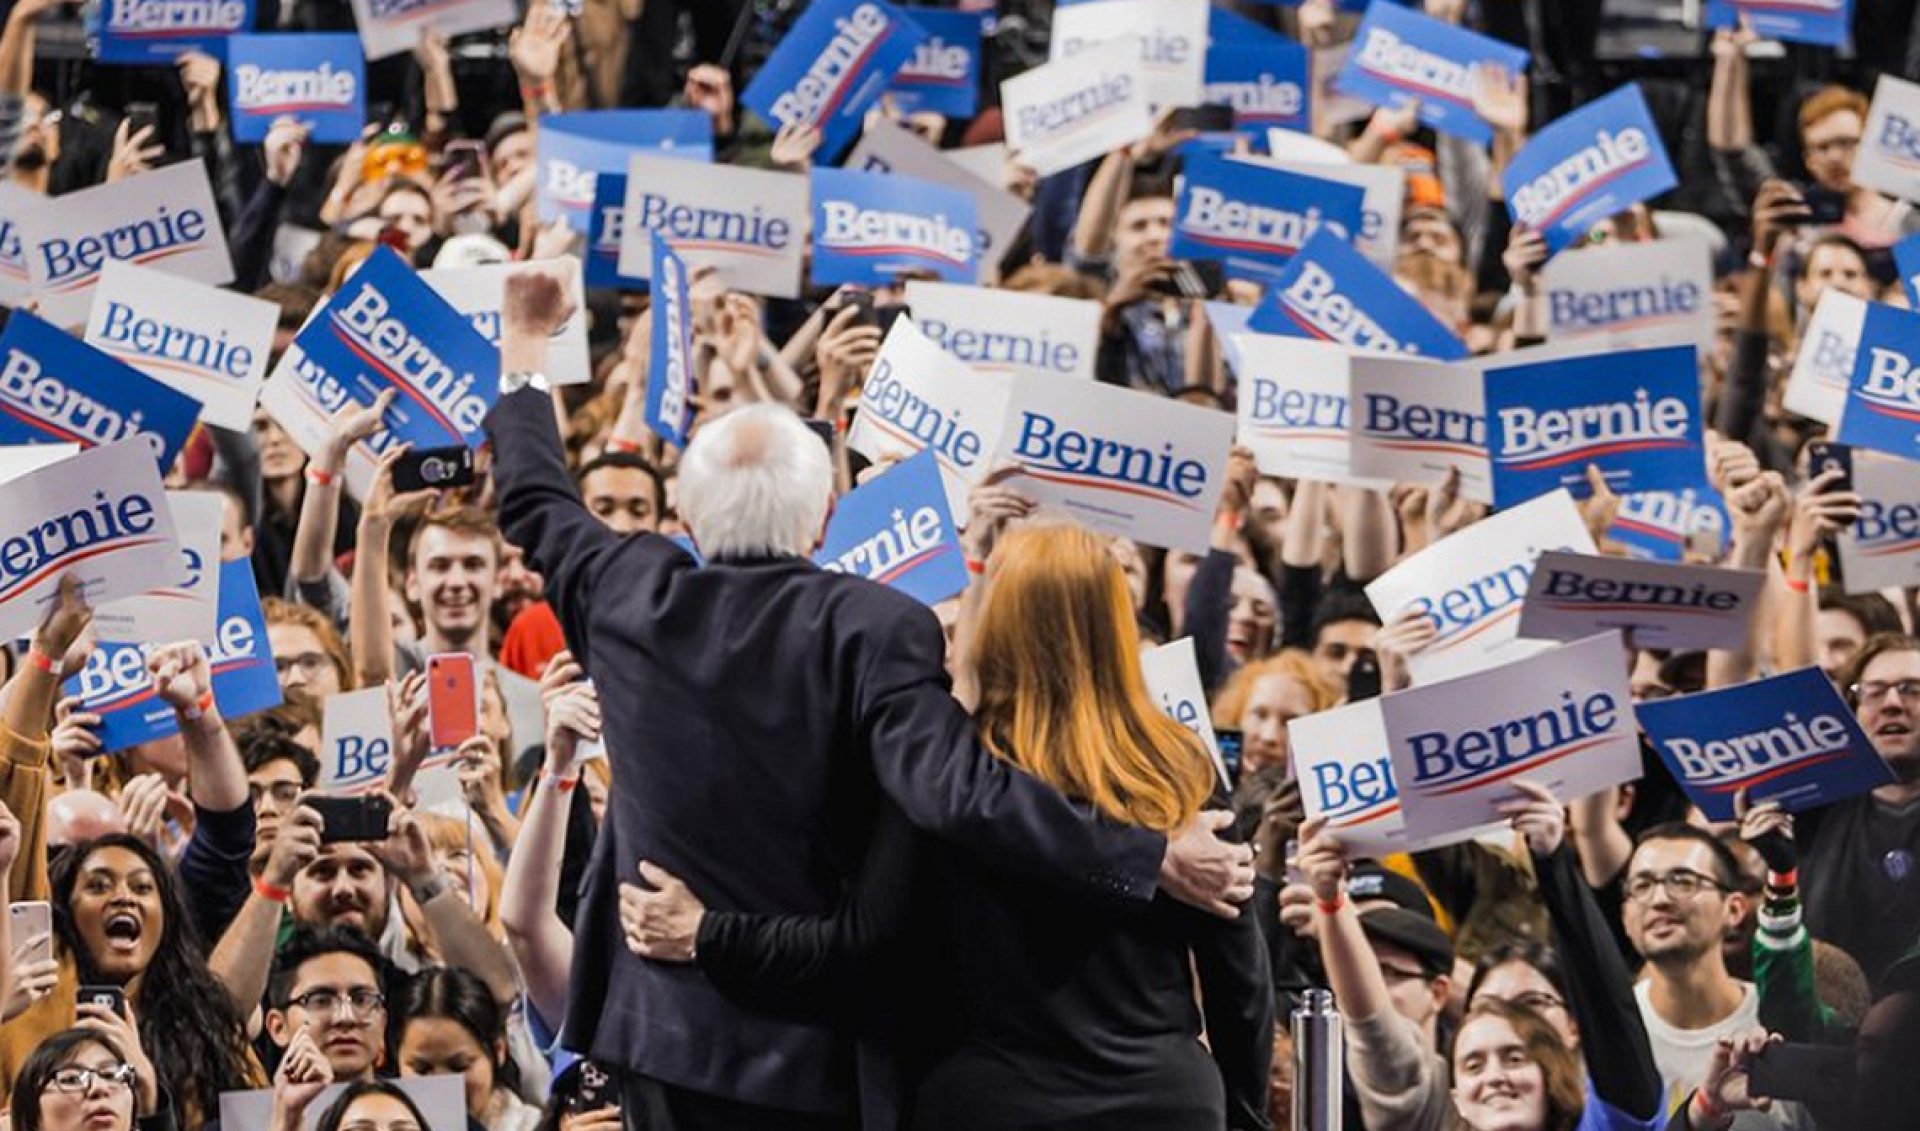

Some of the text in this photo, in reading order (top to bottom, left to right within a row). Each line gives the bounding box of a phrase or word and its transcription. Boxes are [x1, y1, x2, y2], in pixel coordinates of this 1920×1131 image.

[235, 61, 356, 105] Bernie
[39, 205, 207, 281] Bernie
[639, 193, 790, 250] Bernie
[820, 200, 972, 262] Bernie
[1549, 274, 1699, 328] Bernie
[100, 301, 253, 378] Bernie
[339, 282, 489, 434] Bernie
[863, 359, 982, 468] Bernie
[1364, 393, 1486, 447] Bern
[1498, 387, 1689, 456] Bernie
[1013, 411, 1207, 497] Bernie
[0, 489, 154, 577] ernie
[1539, 568, 1744, 612] Bernie
[1406, 691, 1617, 782] Bernie
[1663, 712, 1850, 779] Bernie
